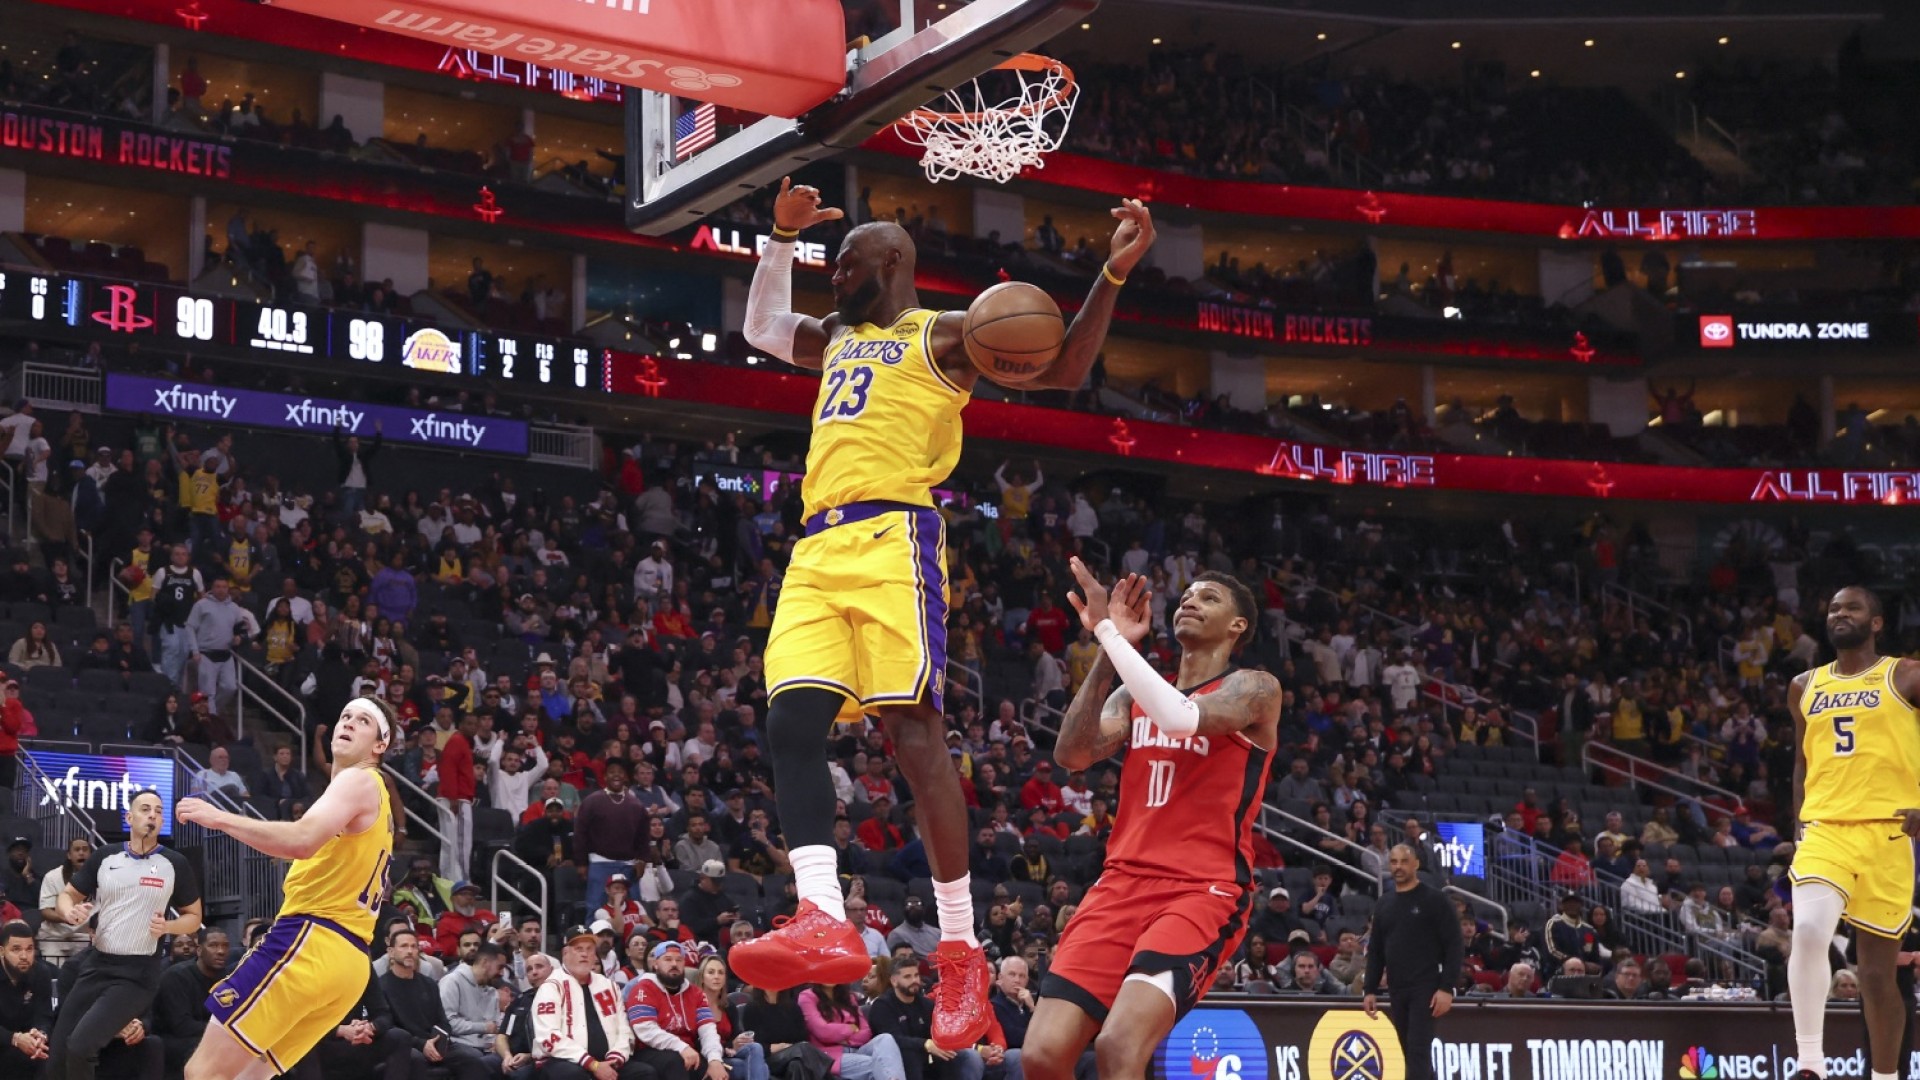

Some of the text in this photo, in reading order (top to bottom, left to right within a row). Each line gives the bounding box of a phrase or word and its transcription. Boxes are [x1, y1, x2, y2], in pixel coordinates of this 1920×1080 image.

[2, 111, 231, 178] OUSTON ROCKETS
[1578, 210, 1757, 236] ALL FIRE
[690, 224, 826, 267] ALL FRE
[32, 295, 45, 320] 0
[177, 296, 213, 340] 90
[257, 307, 307, 344] 40.3
[349, 319, 384, 362] 98
[1198, 302, 1373, 347] HOUSTON ROCKETS
[1737, 322, 1870, 339] TUNDRA ZONE
[498, 338, 517, 356] TOL
[535, 343, 554, 360] FLS
[826, 338, 910, 371] LAKERS
[502, 354, 514, 378] 2
[539, 358, 551, 383] 5
[575, 363, 587, 388] 0
[154, 384, 238, 418] xfinity
[819, 366, 874, 421] 23
[285, 399, 365, 432] xfinity
[410, 413, 486, 446] xfinity
[1270, 442, 1434, 485] ALL FIRE
[195, 483, 209, 495] 77
[1750, 472, 1920, 500] ALL FIR
[234, 556, 248, 568] 77
[174, 586, 184, 600] 6
[1807, 689, 1880, 716] LAKERS
[1833, 716, 1855, 756] 5
[39, 766, 157, 815] xfinit
[1145, 759, 1177, 808] 10
[1432, 835, 1475, 874] nity
[537, 1002, 556, 1016] 22
[593, 988, 618, 1018] H
[541, 1032, 562, 1054] 34
[1431, 1038, 1664, 1080] 0PM ET TOMORROW
[1275, 1045, 1301, 1080] VS
[1718, 1055, 1769, 1079] NBC
[1783, 1048, 1866, 1080] pcock
